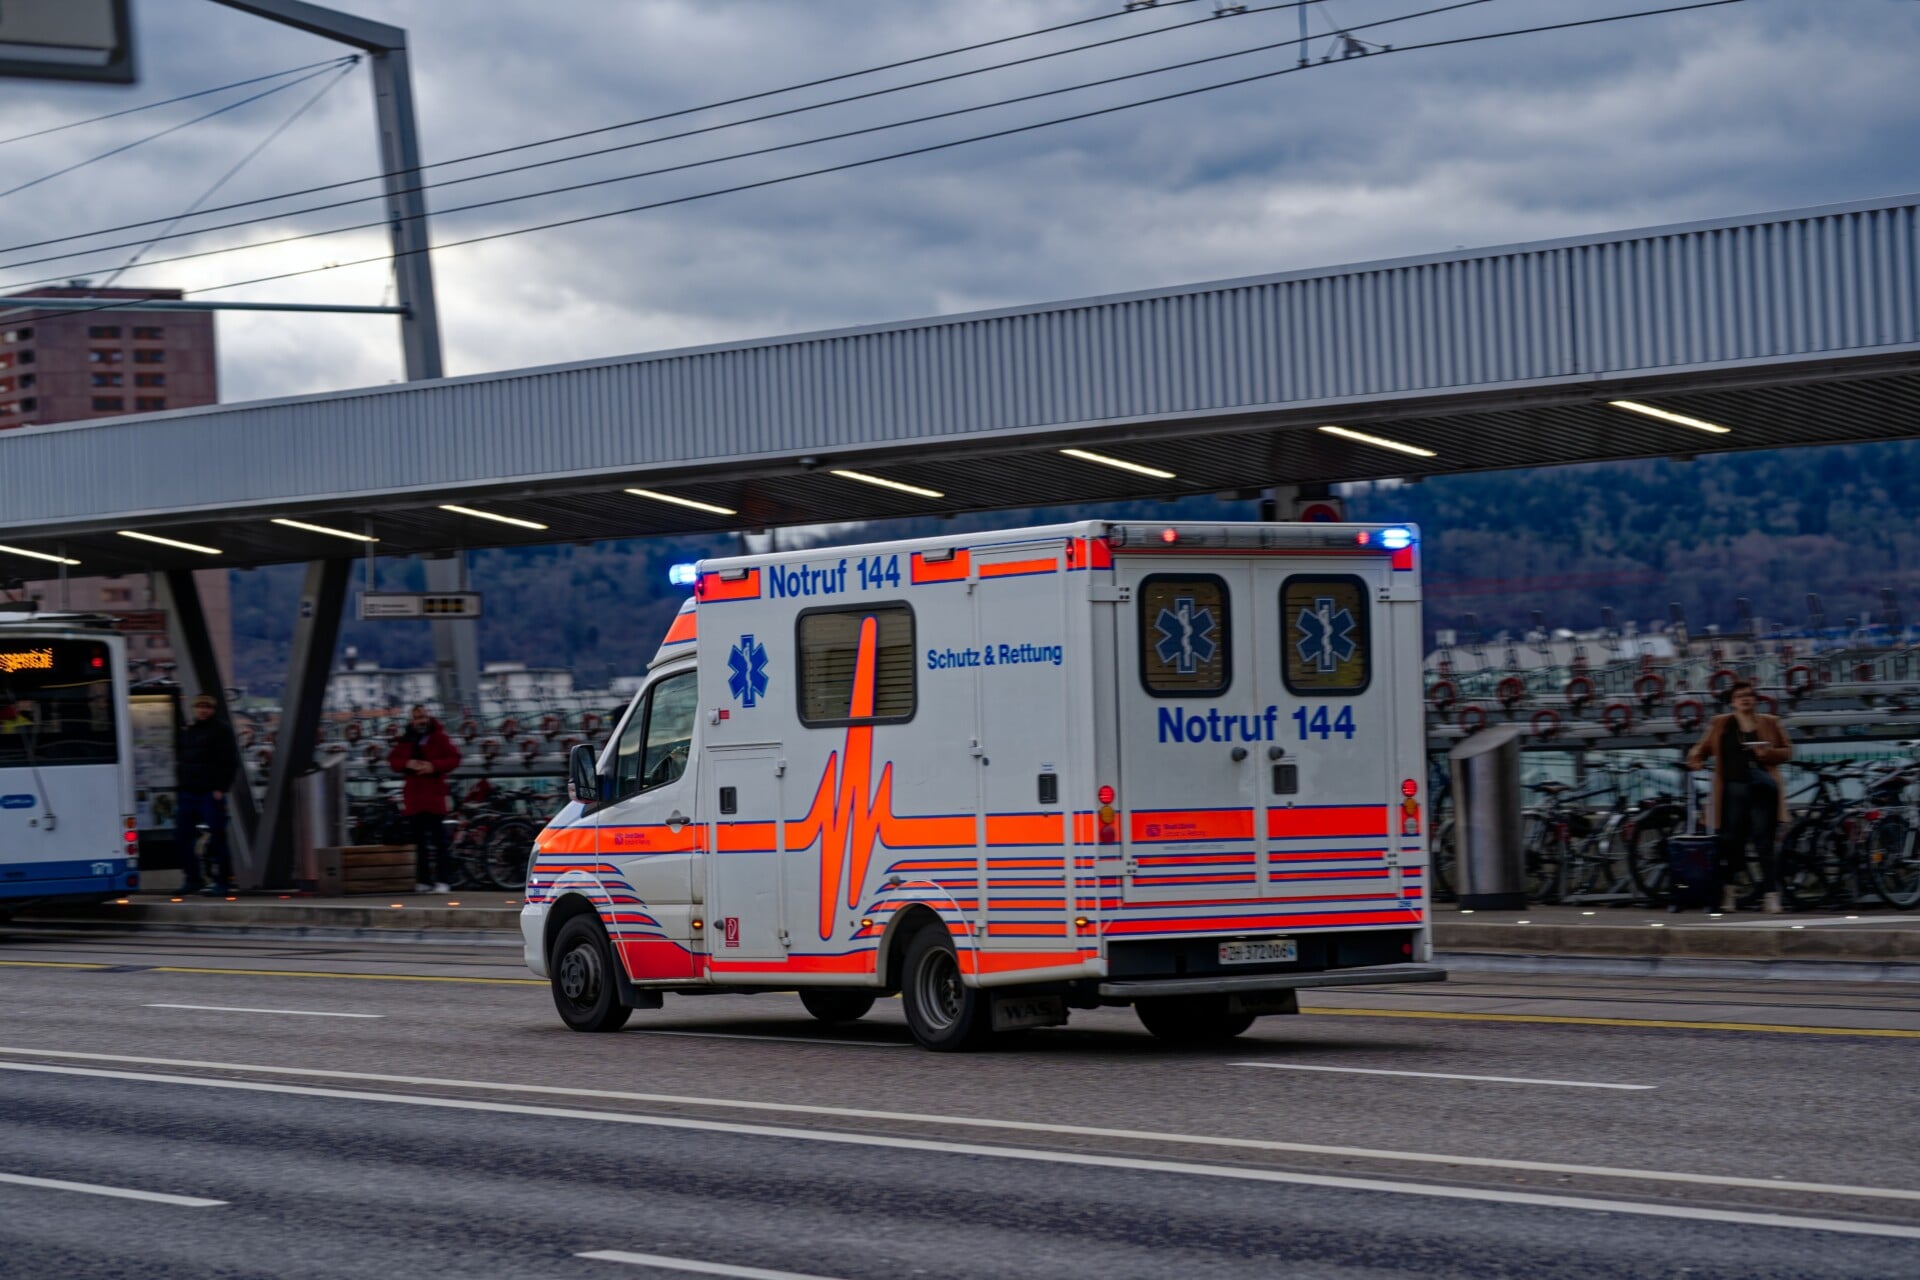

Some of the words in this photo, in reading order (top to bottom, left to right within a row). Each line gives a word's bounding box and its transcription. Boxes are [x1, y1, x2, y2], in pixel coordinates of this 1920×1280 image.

[769, 558, 847, 599] Notruf
[857, 554, 901, 591] 144
[927, 648, 981, 670] Schutz
[984, 644, 996, 666] &
[998, 643, 1063, 666] Rettung
[1158, 705, 1278, 743] Notruf
[1292, 704, 1357, 741] 144
